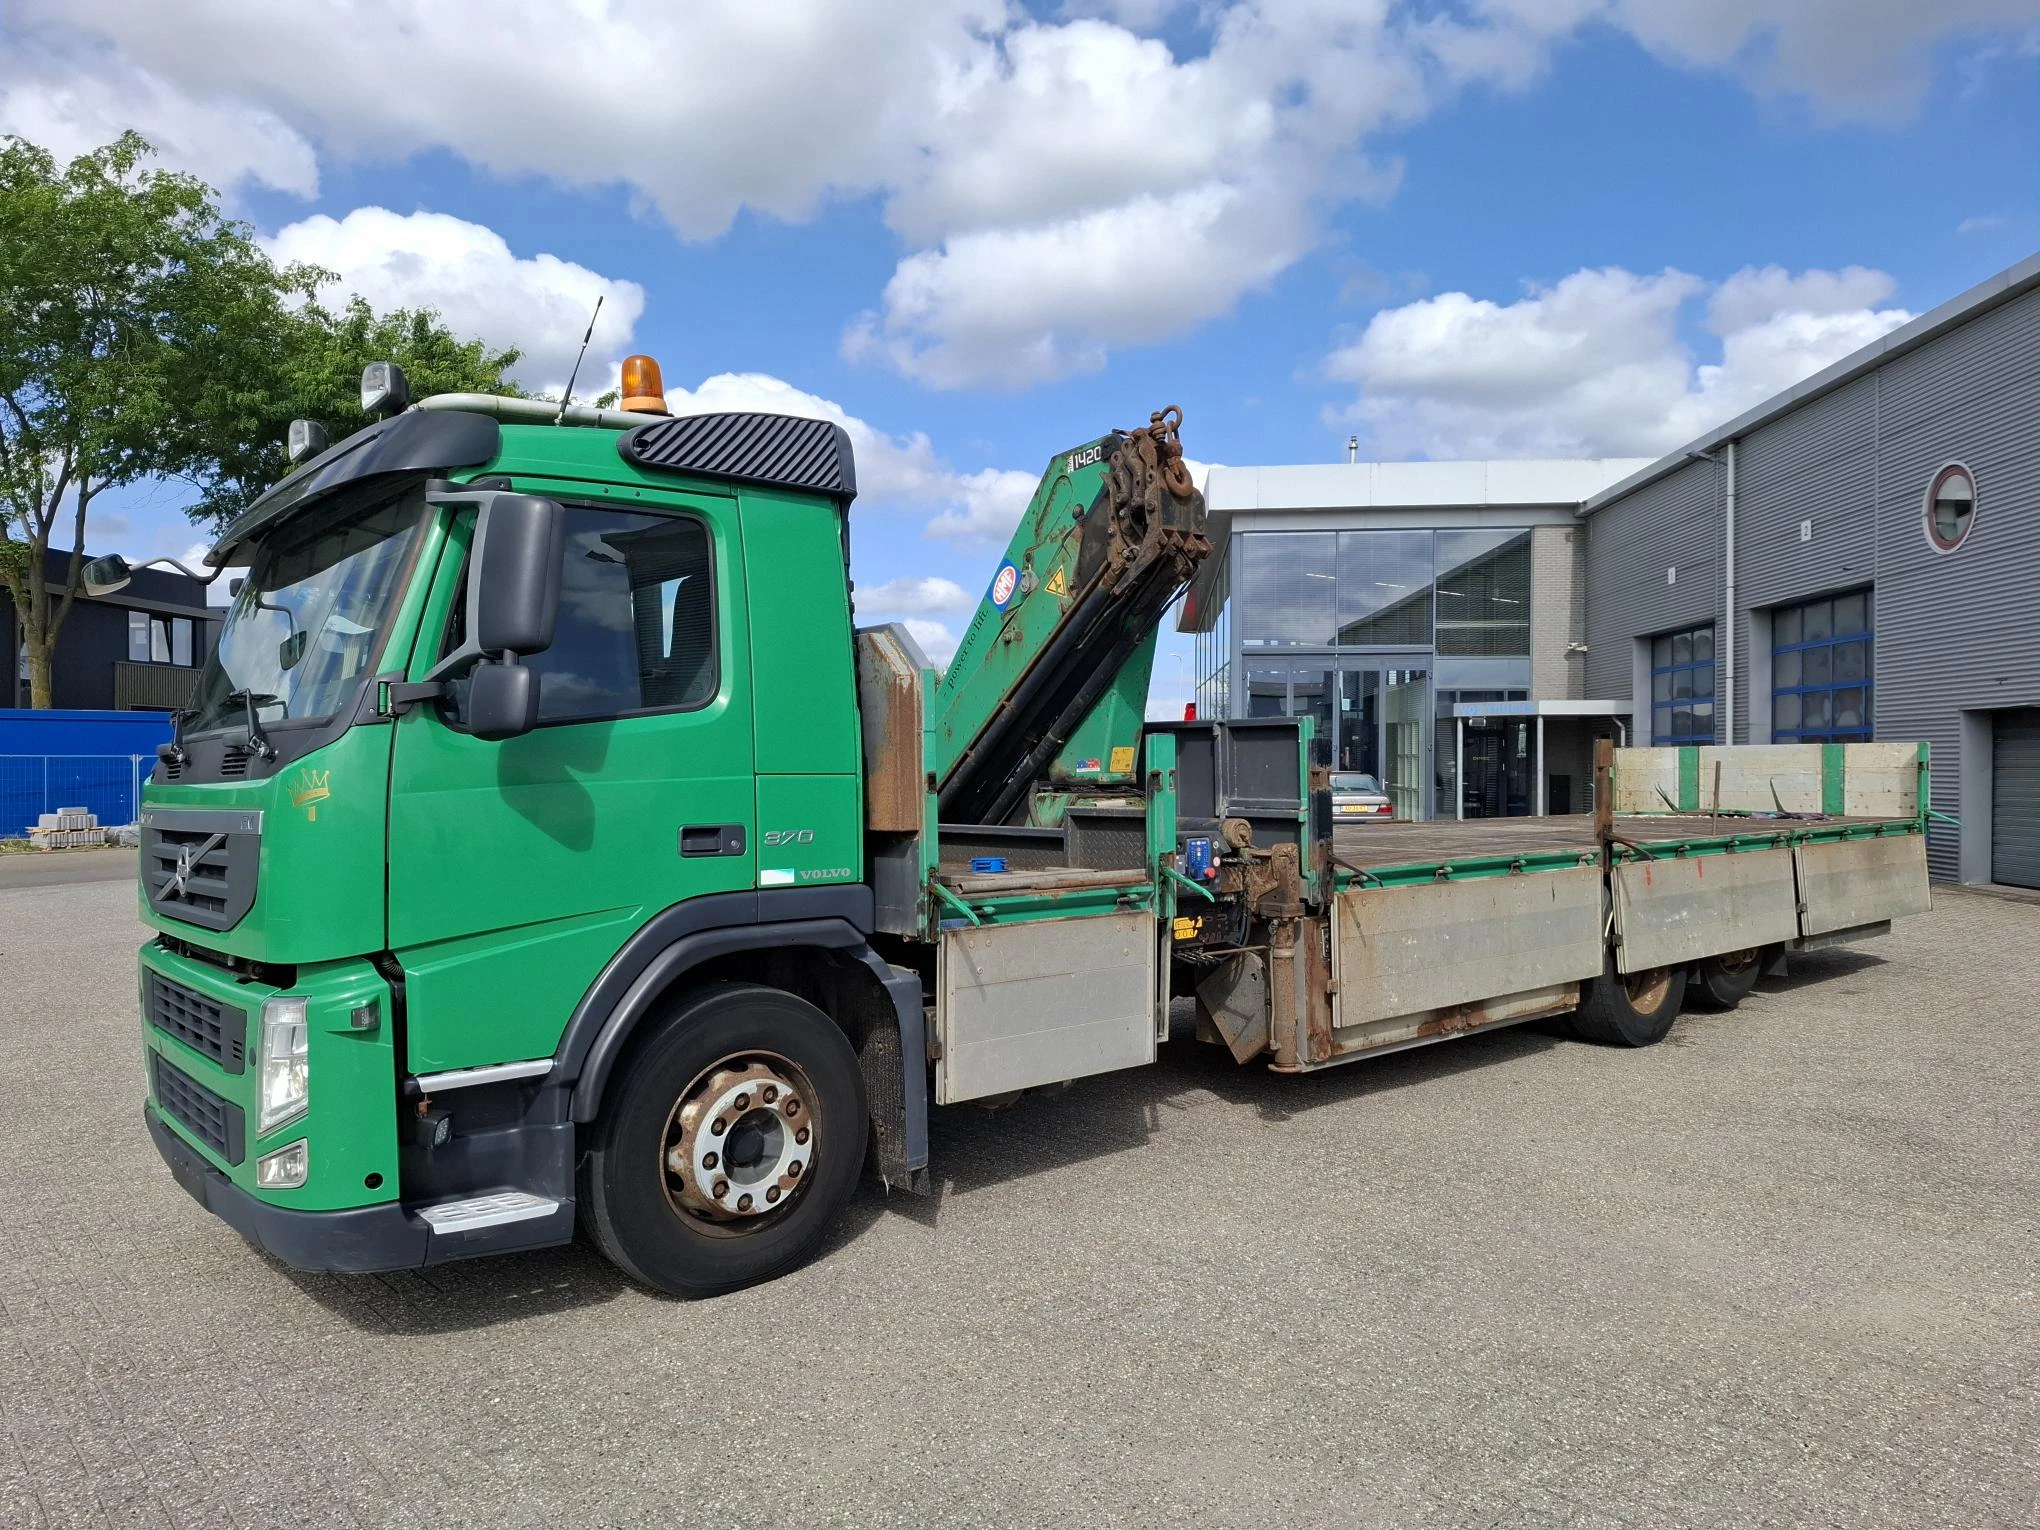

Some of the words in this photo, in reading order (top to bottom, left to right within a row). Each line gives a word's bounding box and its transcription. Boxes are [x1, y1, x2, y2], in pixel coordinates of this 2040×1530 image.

[1074, 446, 1102, 469] 1420
[994, 568, 1014, 601] HMF
[947, 648, 968, 690] power
[967, 632, 976, 646] to
[764, 830, 814, 846] 370
[800, 868, 851, 880] VOLVO
